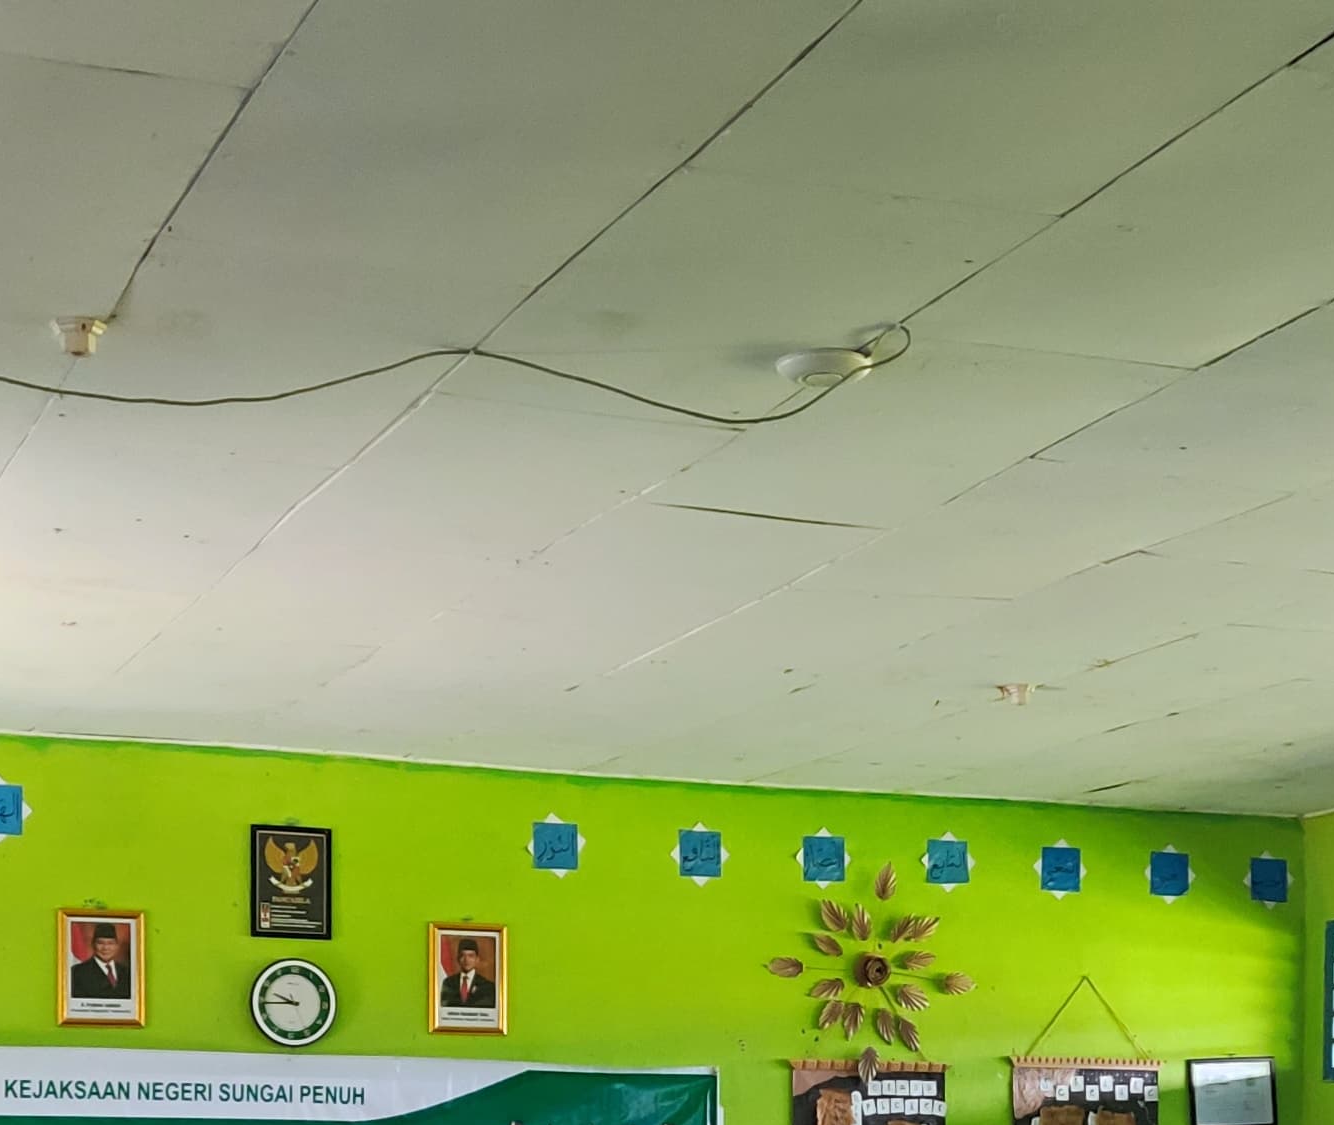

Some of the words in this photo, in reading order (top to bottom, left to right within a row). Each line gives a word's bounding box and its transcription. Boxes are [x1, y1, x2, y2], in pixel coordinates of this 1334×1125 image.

[4, 1079, 130, 1101] KEJAKSAAN
[137, 1081, 212, 1102] NEGERI
[218, 1083, 294, 1103] SUNGAI
[299, 1085, 365, 1106] PENUH
